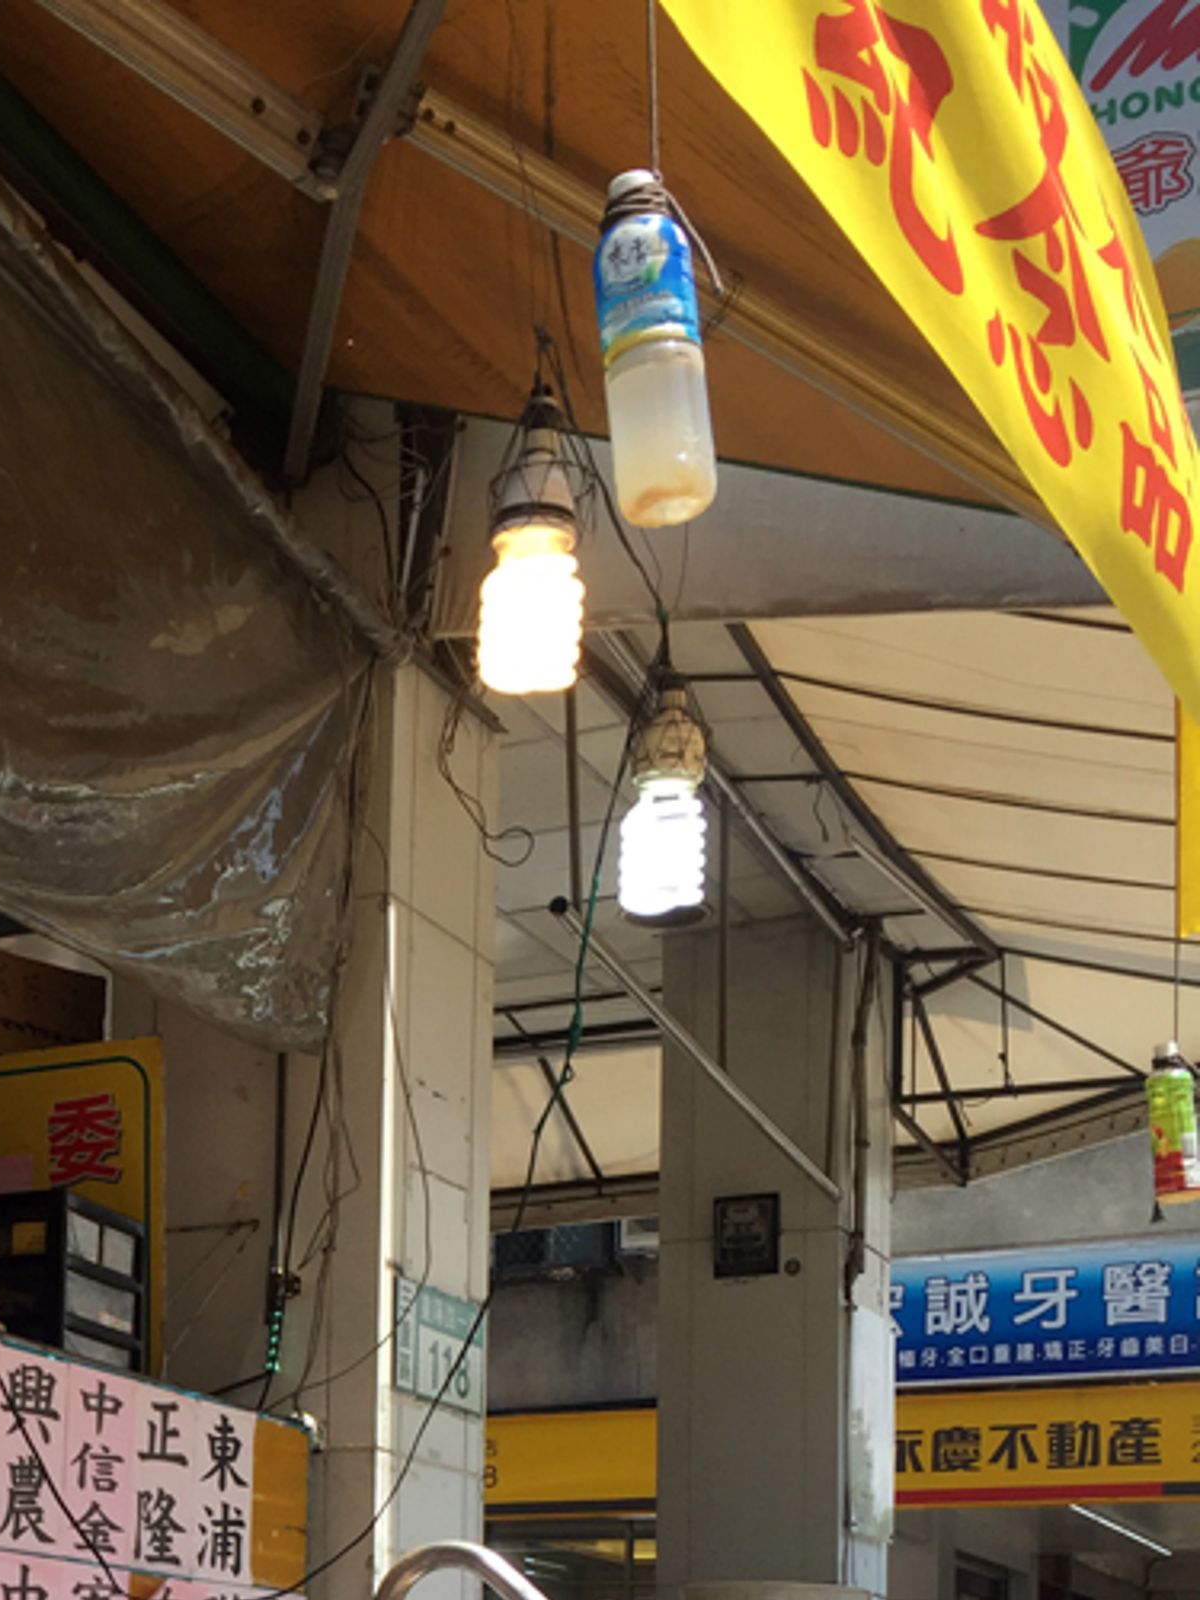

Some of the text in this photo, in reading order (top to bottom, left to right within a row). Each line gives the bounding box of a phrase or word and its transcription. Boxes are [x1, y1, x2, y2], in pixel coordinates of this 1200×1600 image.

[1091, 77, 1200, 126] HON
[890, 1262, 1200, 1337] 誠牙醫
[71, 1381, 126, 1556] 中信金
[134, 1401, 189, 1568] 正隆
[197, 1413, 248, 1577] 東浦
